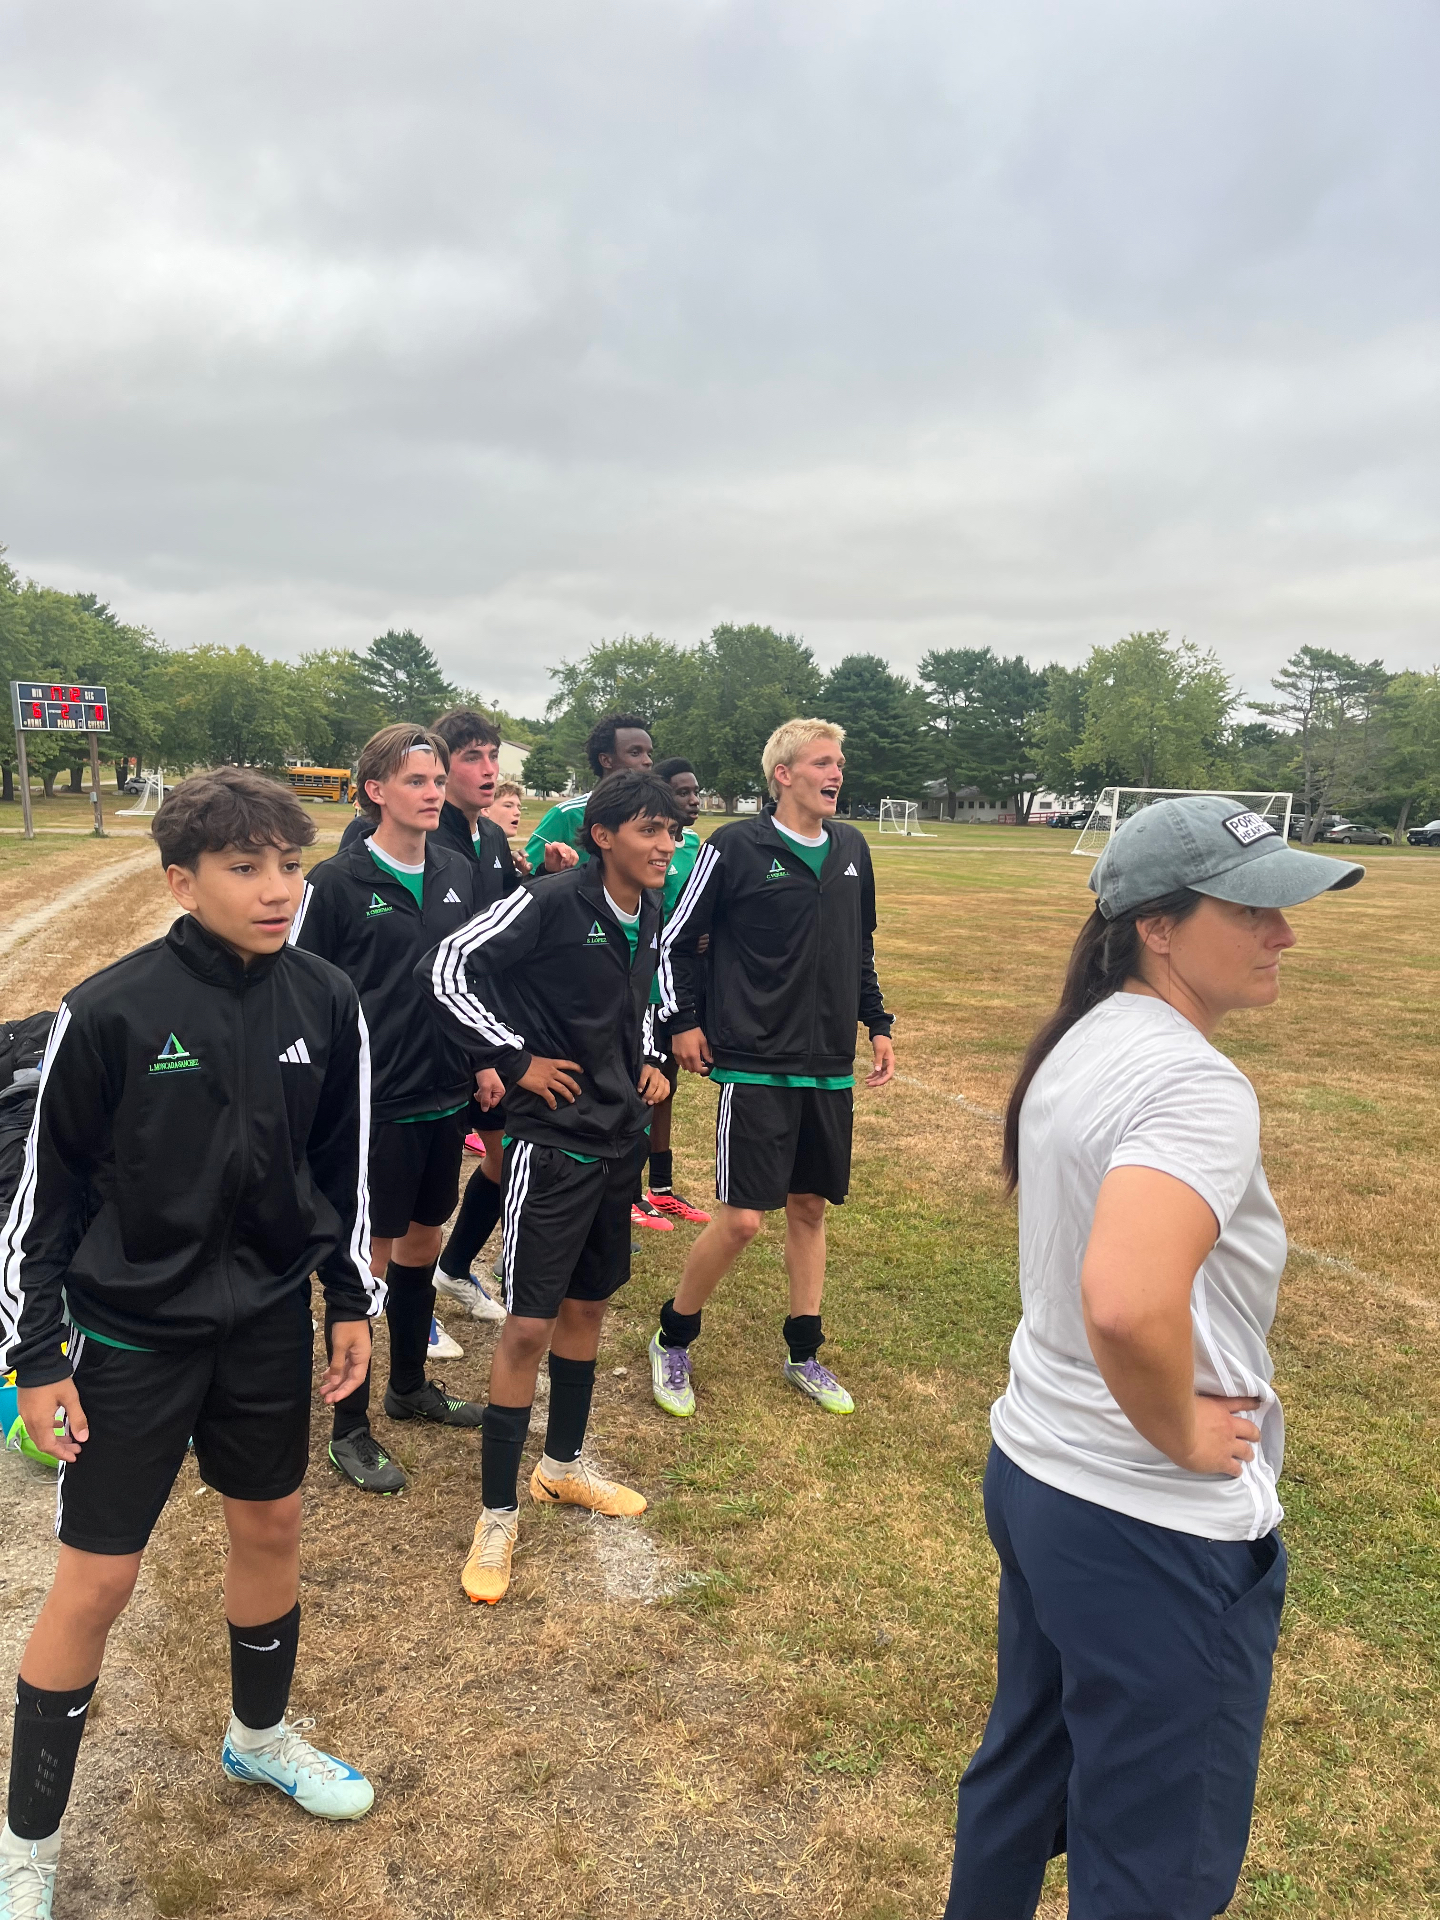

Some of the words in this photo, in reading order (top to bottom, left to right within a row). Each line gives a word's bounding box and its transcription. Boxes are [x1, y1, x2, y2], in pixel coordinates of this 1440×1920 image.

[32, 702, 42, 718] 6
[61, 703, 70, 719] 2
[94, 705, 104, 721] 0
